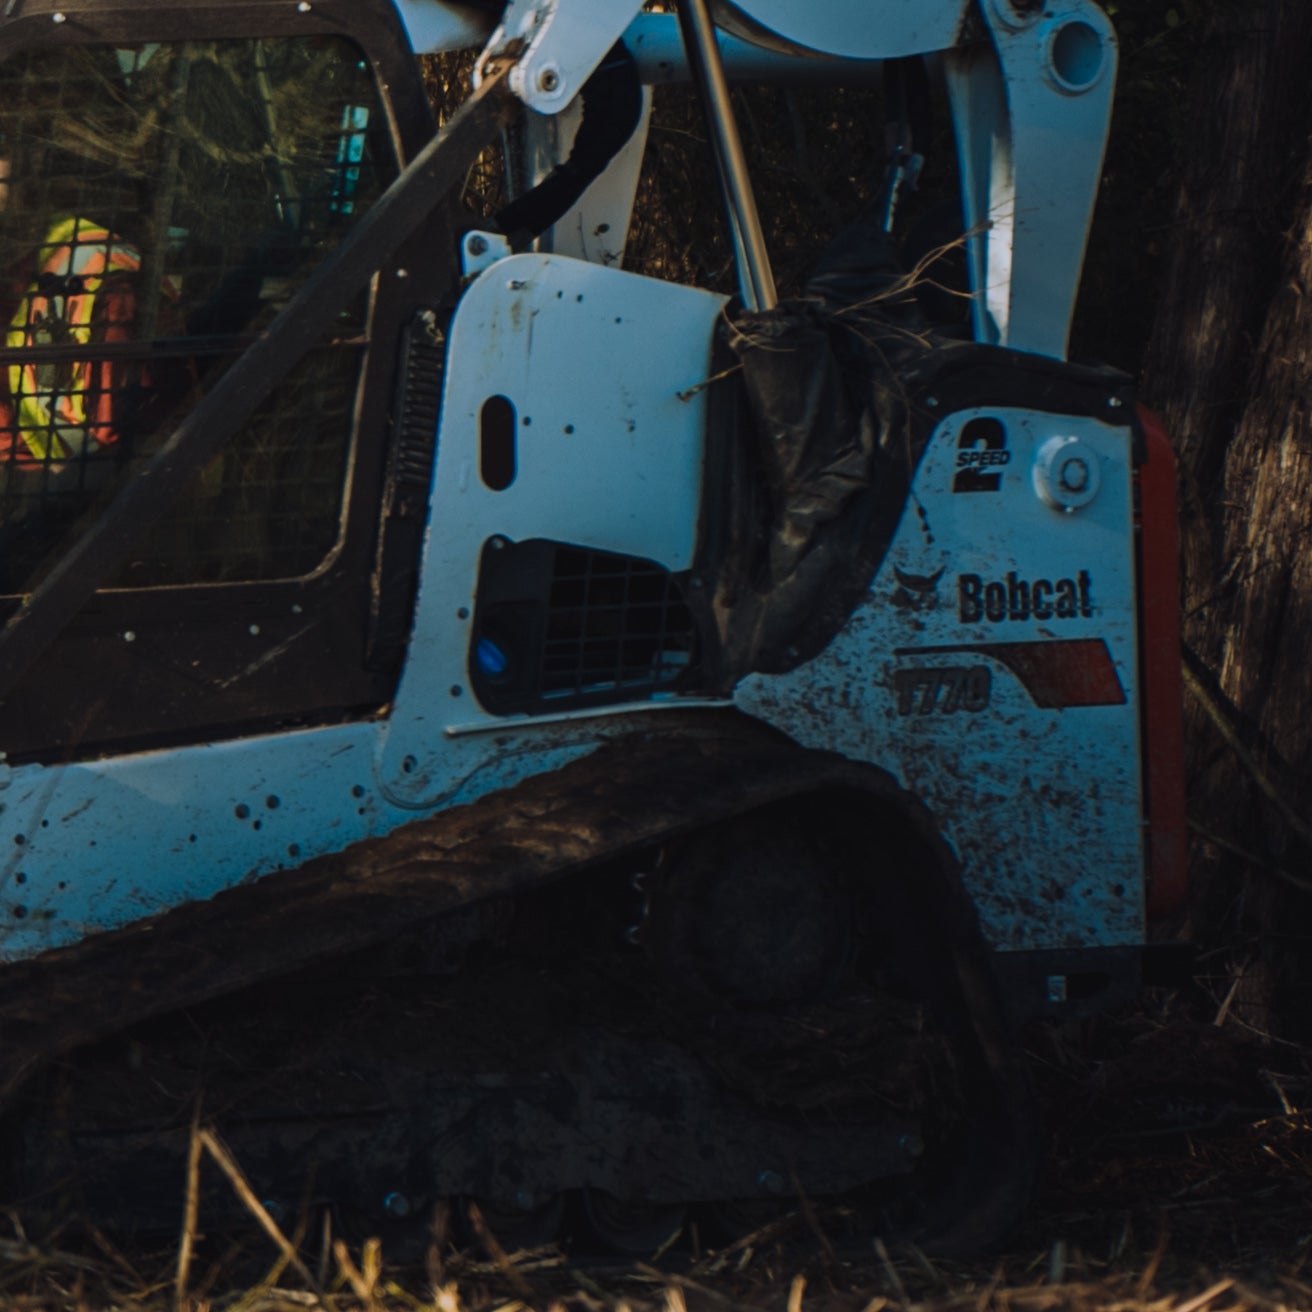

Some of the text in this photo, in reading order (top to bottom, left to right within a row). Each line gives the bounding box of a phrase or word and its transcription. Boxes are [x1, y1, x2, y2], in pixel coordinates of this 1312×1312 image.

[953, 417, 1004, 492] 2
[956, 450, 1010, 467] SPEED
[959, 569, 1092, 623] Bobcat
